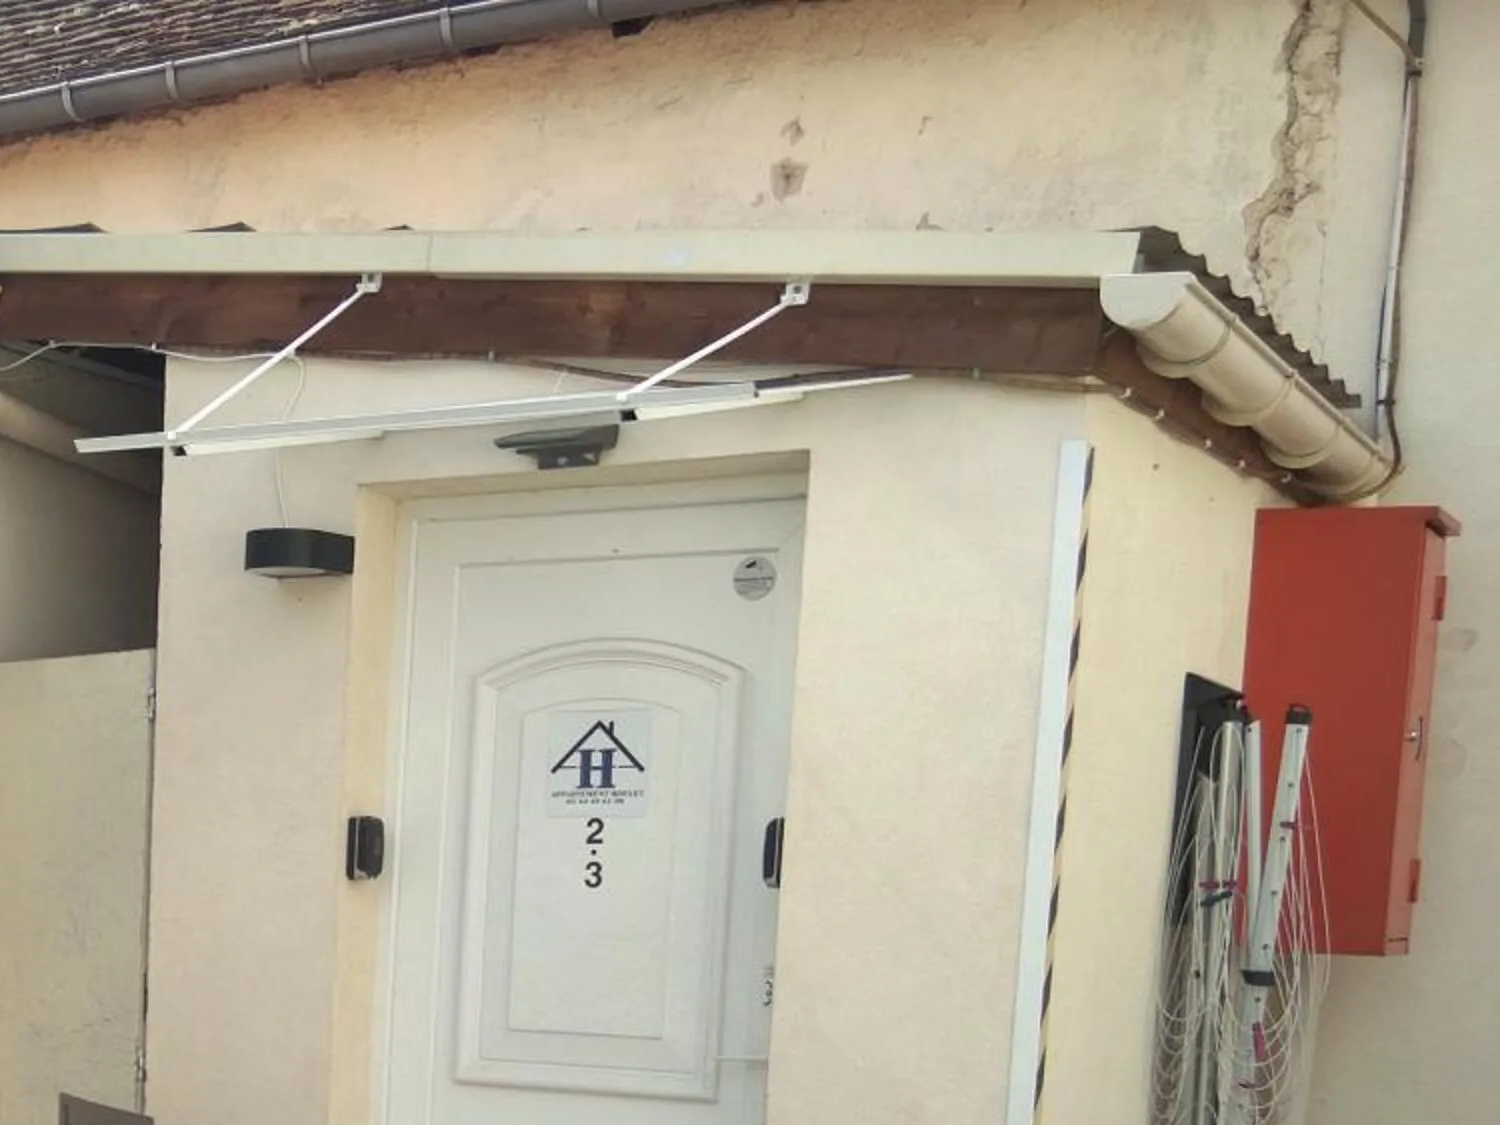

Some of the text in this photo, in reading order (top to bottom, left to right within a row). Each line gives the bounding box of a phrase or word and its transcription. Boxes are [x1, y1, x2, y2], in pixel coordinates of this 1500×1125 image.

[577, 749, 617, 789] H
[586, 817, 605, 845] 2
[584, 861, 603, 889] 3
